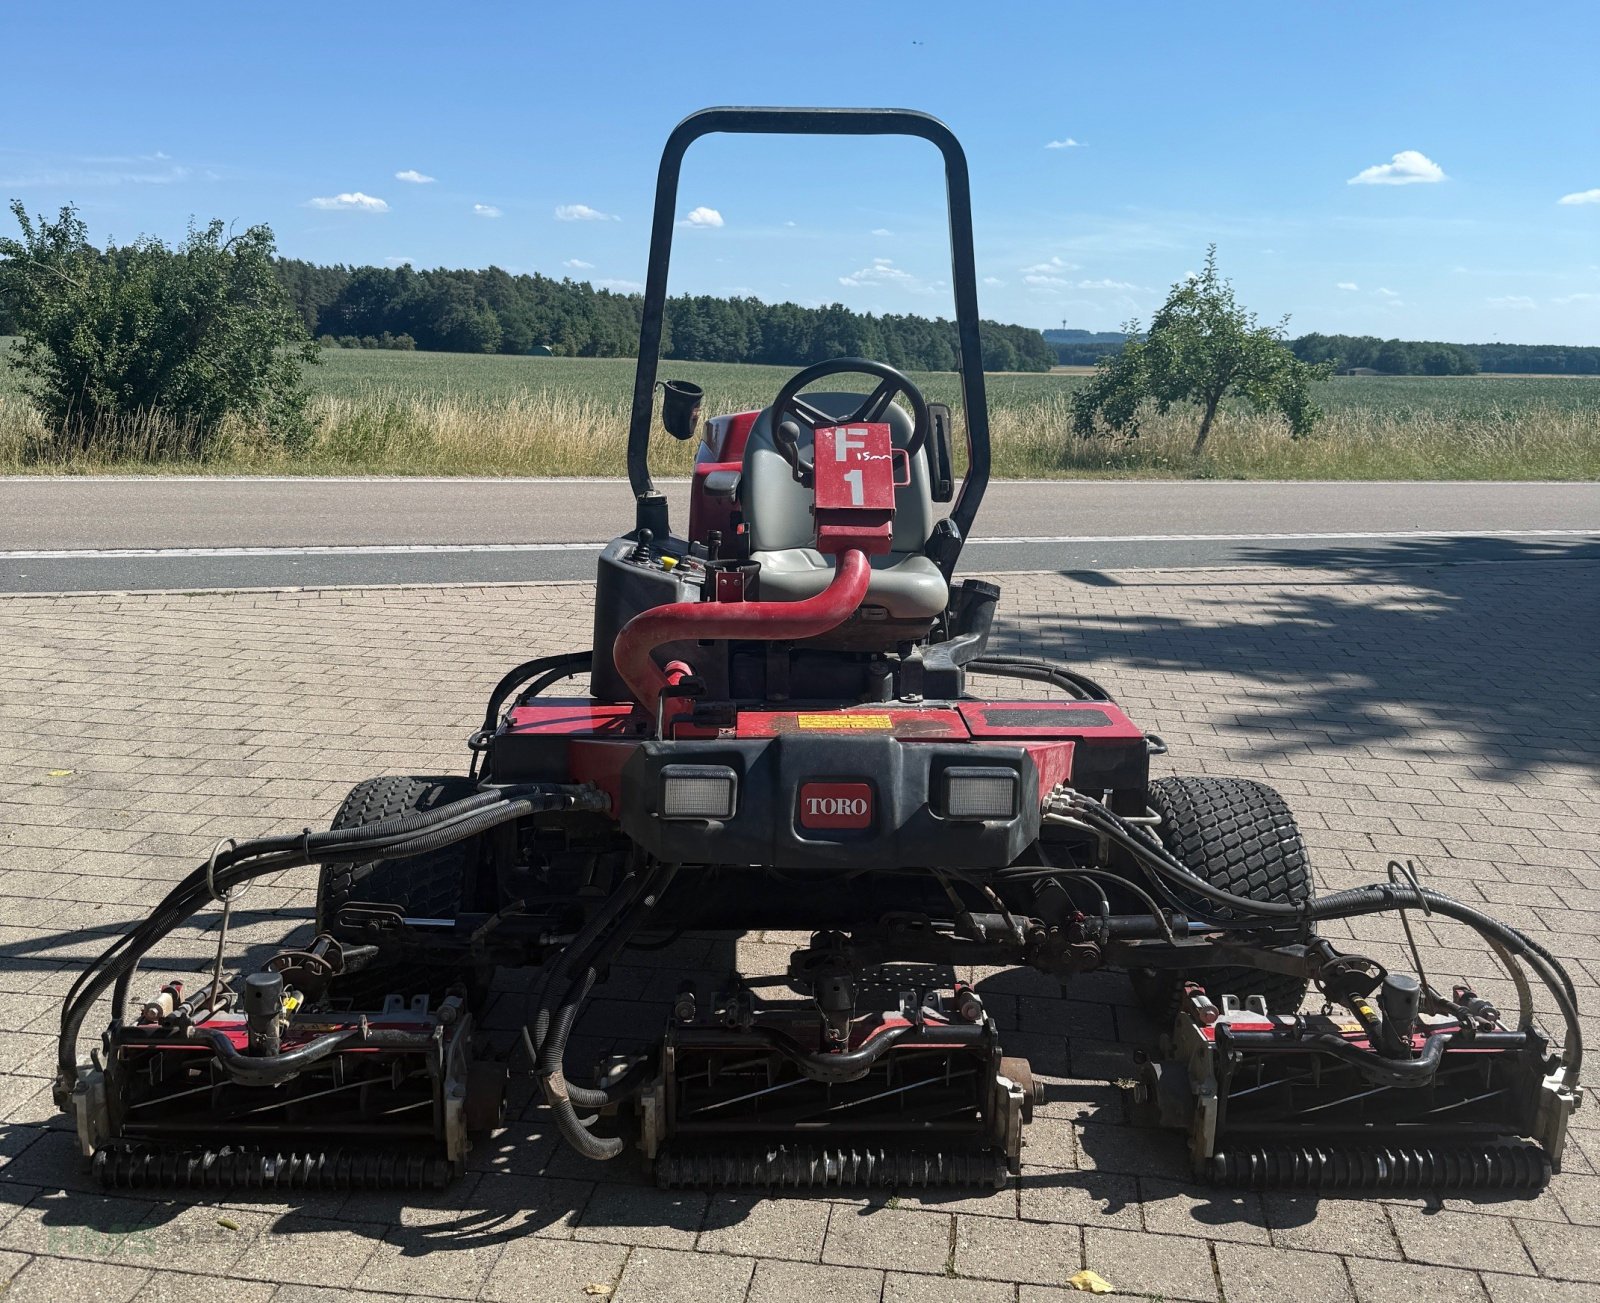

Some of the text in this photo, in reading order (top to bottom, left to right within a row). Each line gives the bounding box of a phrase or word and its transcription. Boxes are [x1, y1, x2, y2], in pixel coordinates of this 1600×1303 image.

[835, 428, 868, 462] F
[843, 469, 864, 506] 1
[806, 798, 868, 816] TORO
